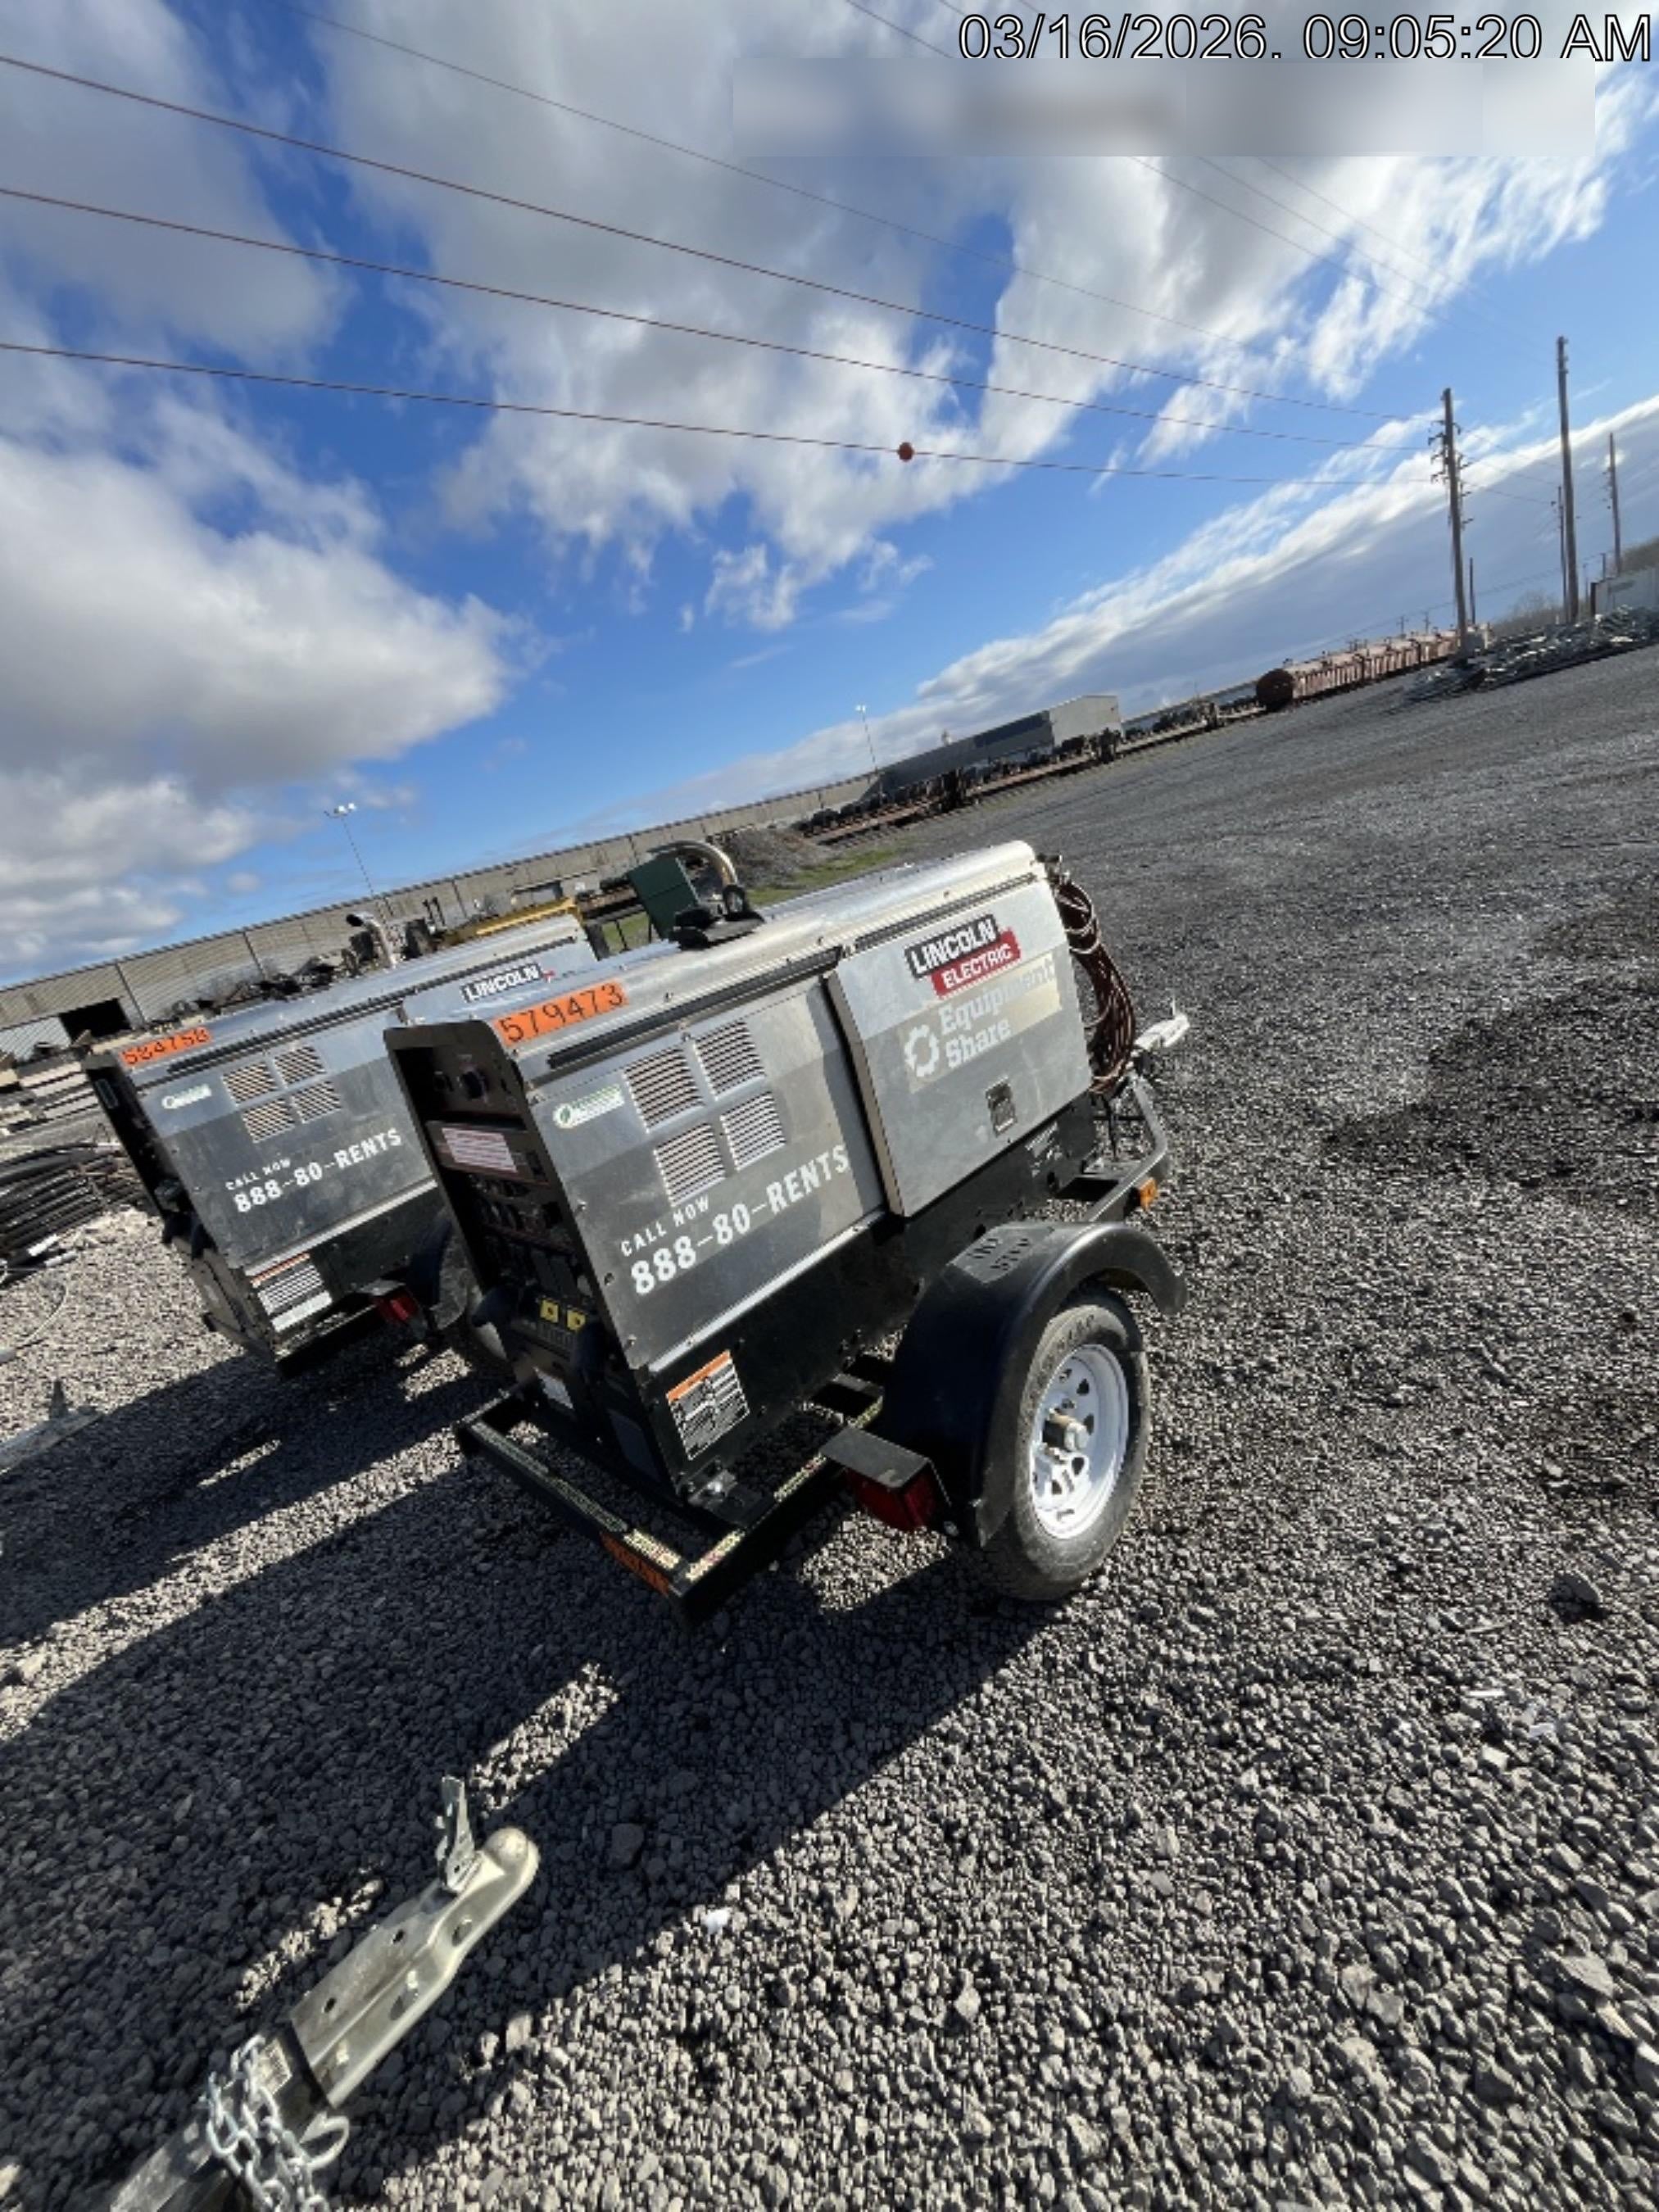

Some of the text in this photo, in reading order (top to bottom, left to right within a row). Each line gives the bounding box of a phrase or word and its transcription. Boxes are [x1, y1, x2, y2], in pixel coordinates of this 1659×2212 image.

[909, 917, 996, 974] LINCOLN
[941, 943, 1013, 989] ELECTRIC
[464, 965, 540, 999] LINCOLN
[498, 983, 623, 1042] 579473
[945, 1019, 1012, 1068] Share
[225, 1158, 291, 1190] CALL NOW
[233, 1127, 401, 1213] 888-80-RENTS
[621, 1194, 709, 1256] CALL NOW
[631, 1145, 850, 1294] 888-80-RENTS
